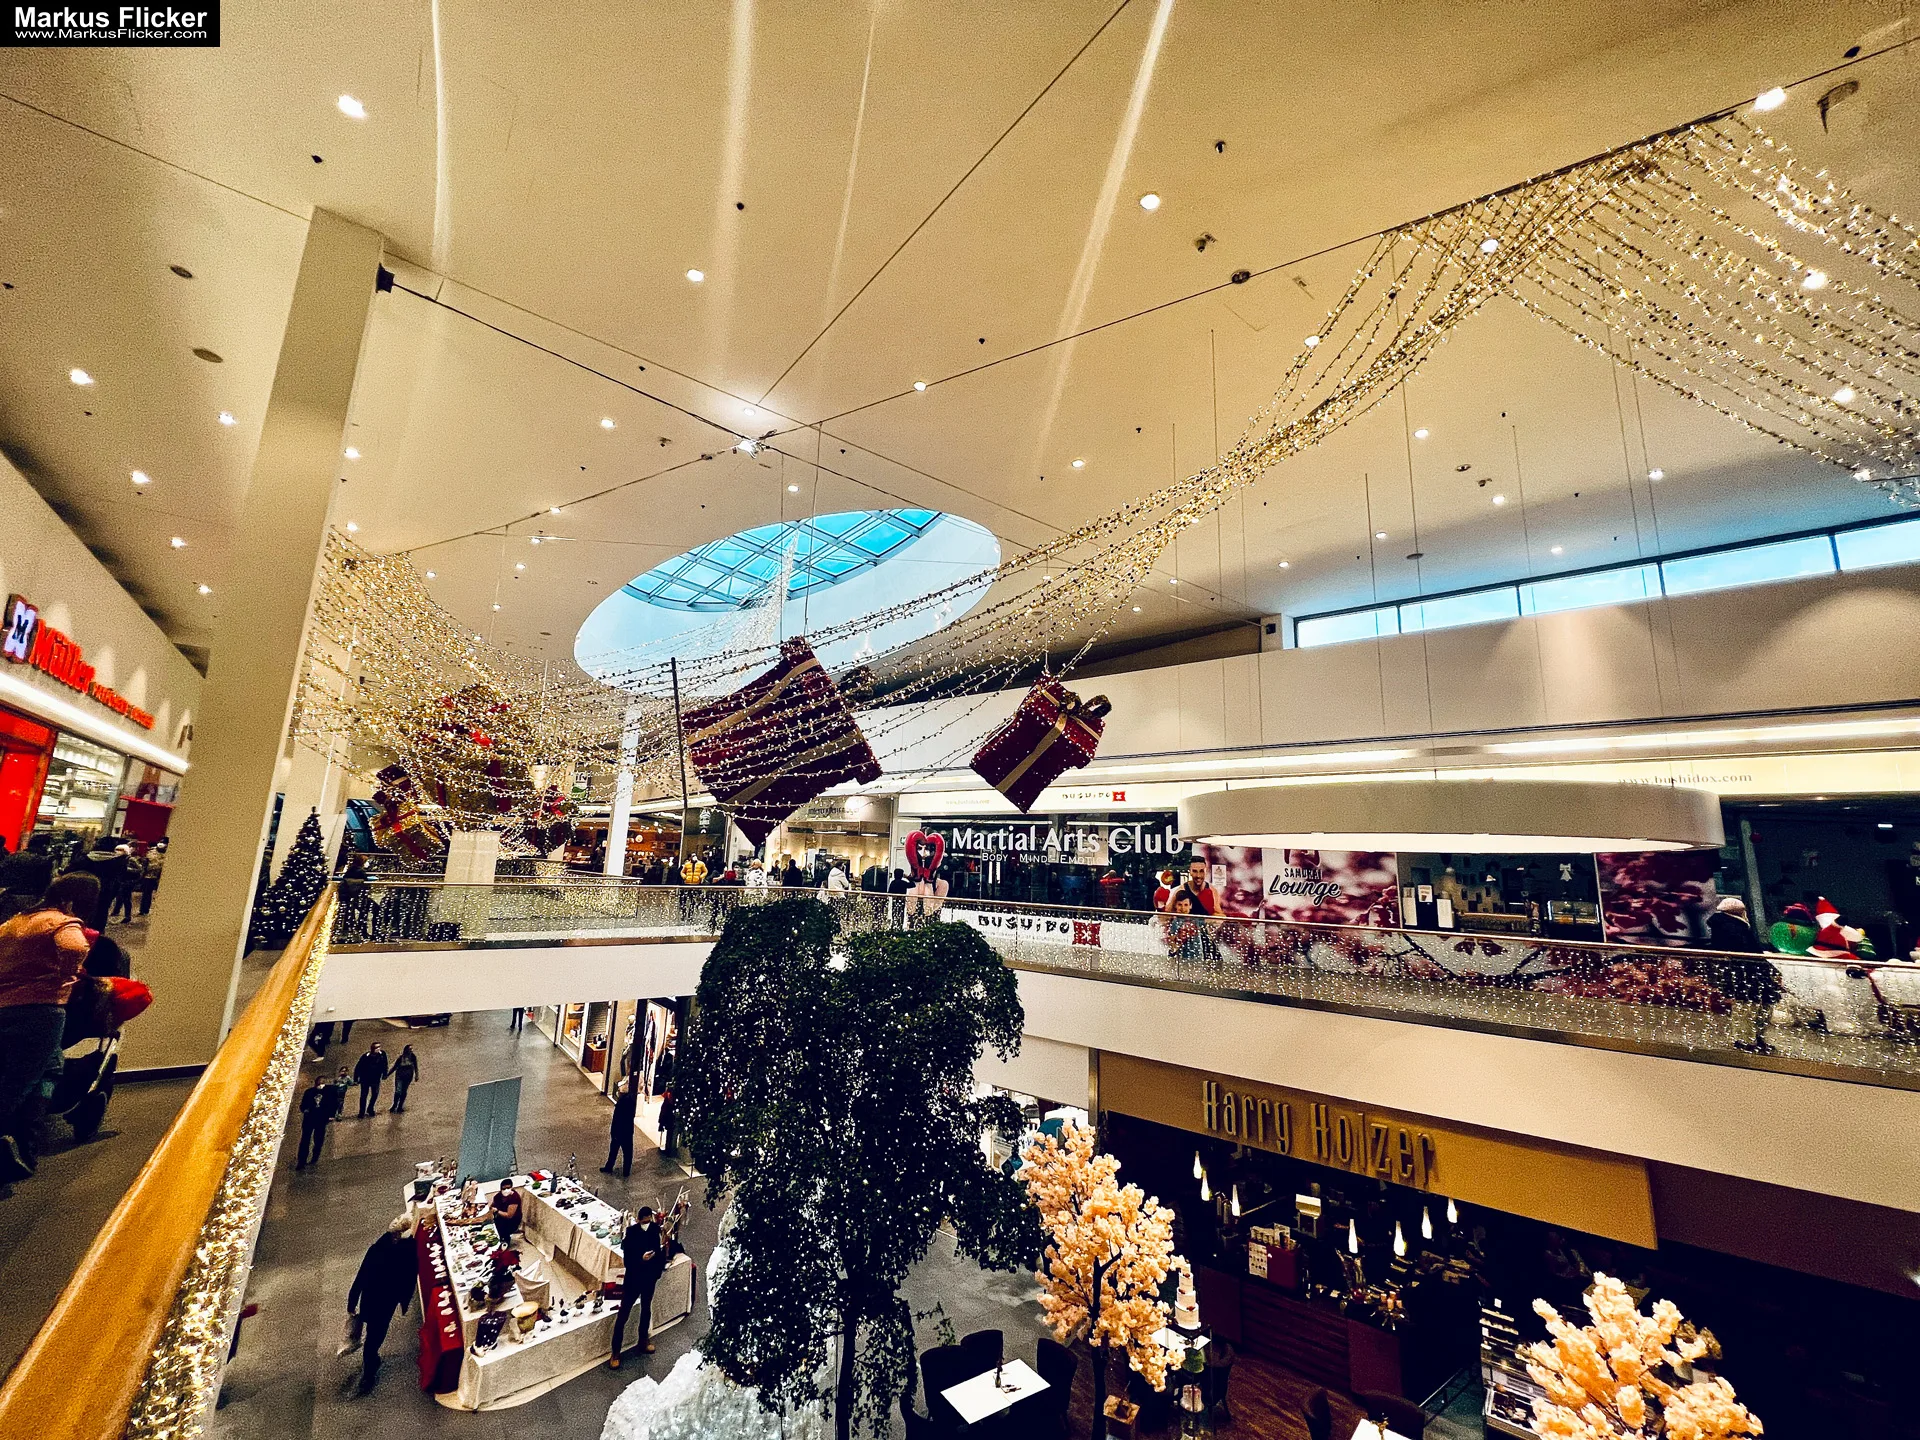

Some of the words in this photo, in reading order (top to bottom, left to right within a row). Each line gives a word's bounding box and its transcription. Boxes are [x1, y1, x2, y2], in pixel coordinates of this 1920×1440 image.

[952, 824, 1037, 852] Martial
[1042, 827, 1101, 853] Arts
[1108, 824, 1185, 855] Club
[982, 852, 1009, 862] BODY
[1019, 853, 1048, 863] MIND
[1060, 854, 1113, 866] EMOTION
[1284, 867, 1323, 880] SAMURAI
[1268, 874, 1343, 907] Lounge
[1201, 1079, 1291, 1156] Harry
[1310, 1102, 1436, 1190] Holzer
